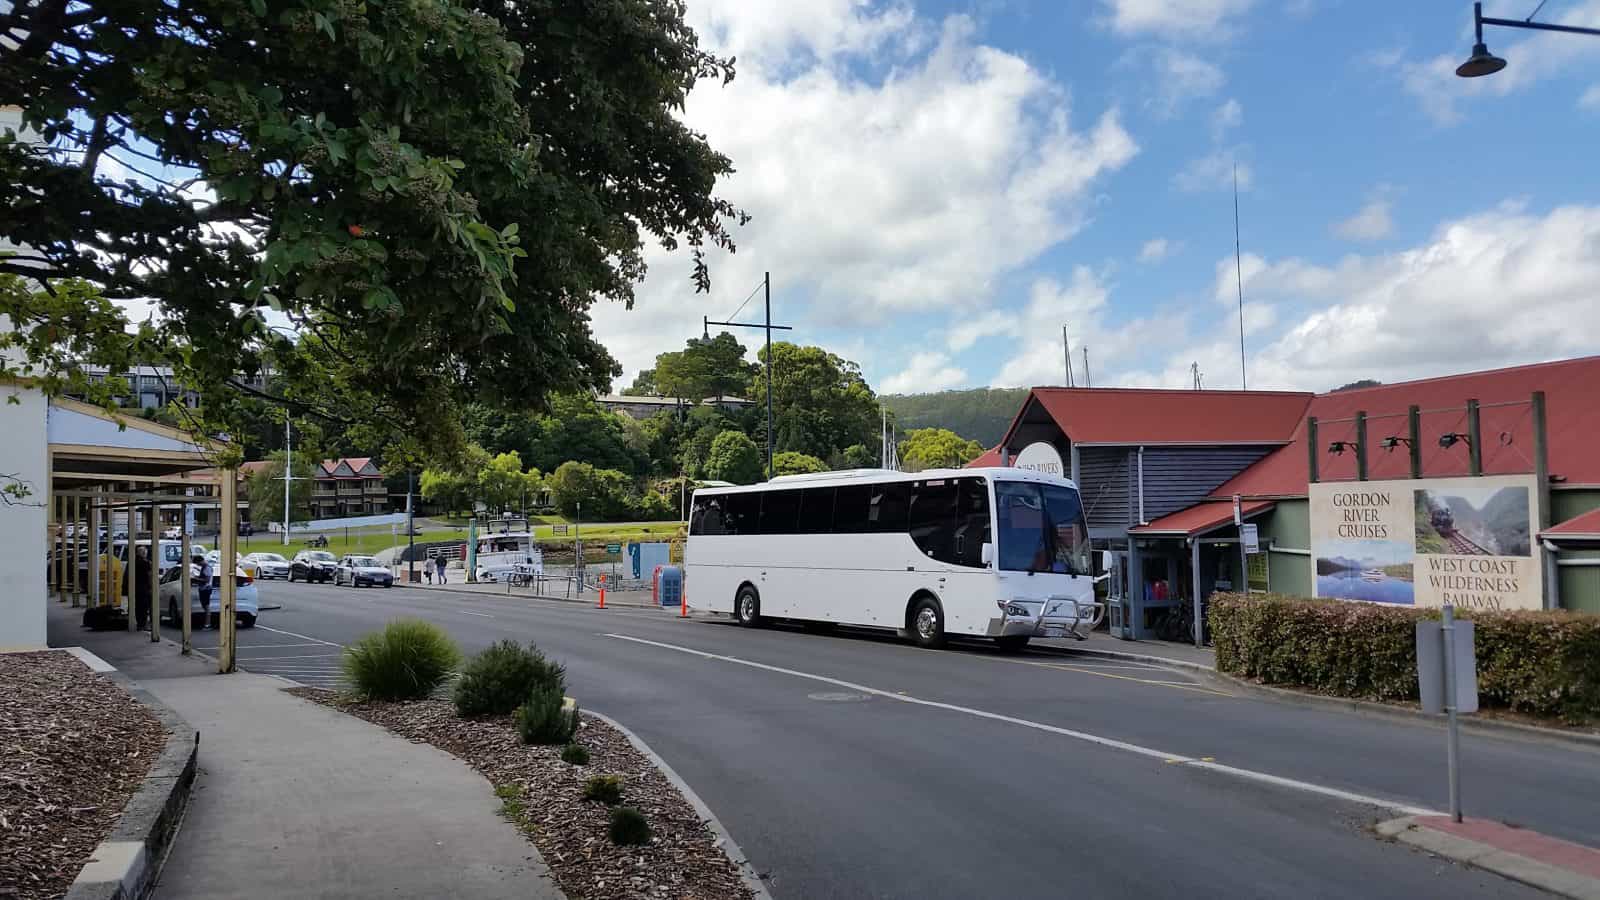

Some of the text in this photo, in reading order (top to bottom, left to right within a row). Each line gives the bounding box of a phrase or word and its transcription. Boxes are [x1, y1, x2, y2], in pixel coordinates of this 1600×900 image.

[1333, 492, 1391, 507] GORDON
[1344, 508, 1380, 522] RIVER
[1338, 524, 1388, 538] CRUISES
[1428, 557, 1518, 575] WEST COAST
[1428, 575, 1519, 593] WILDERNESS
